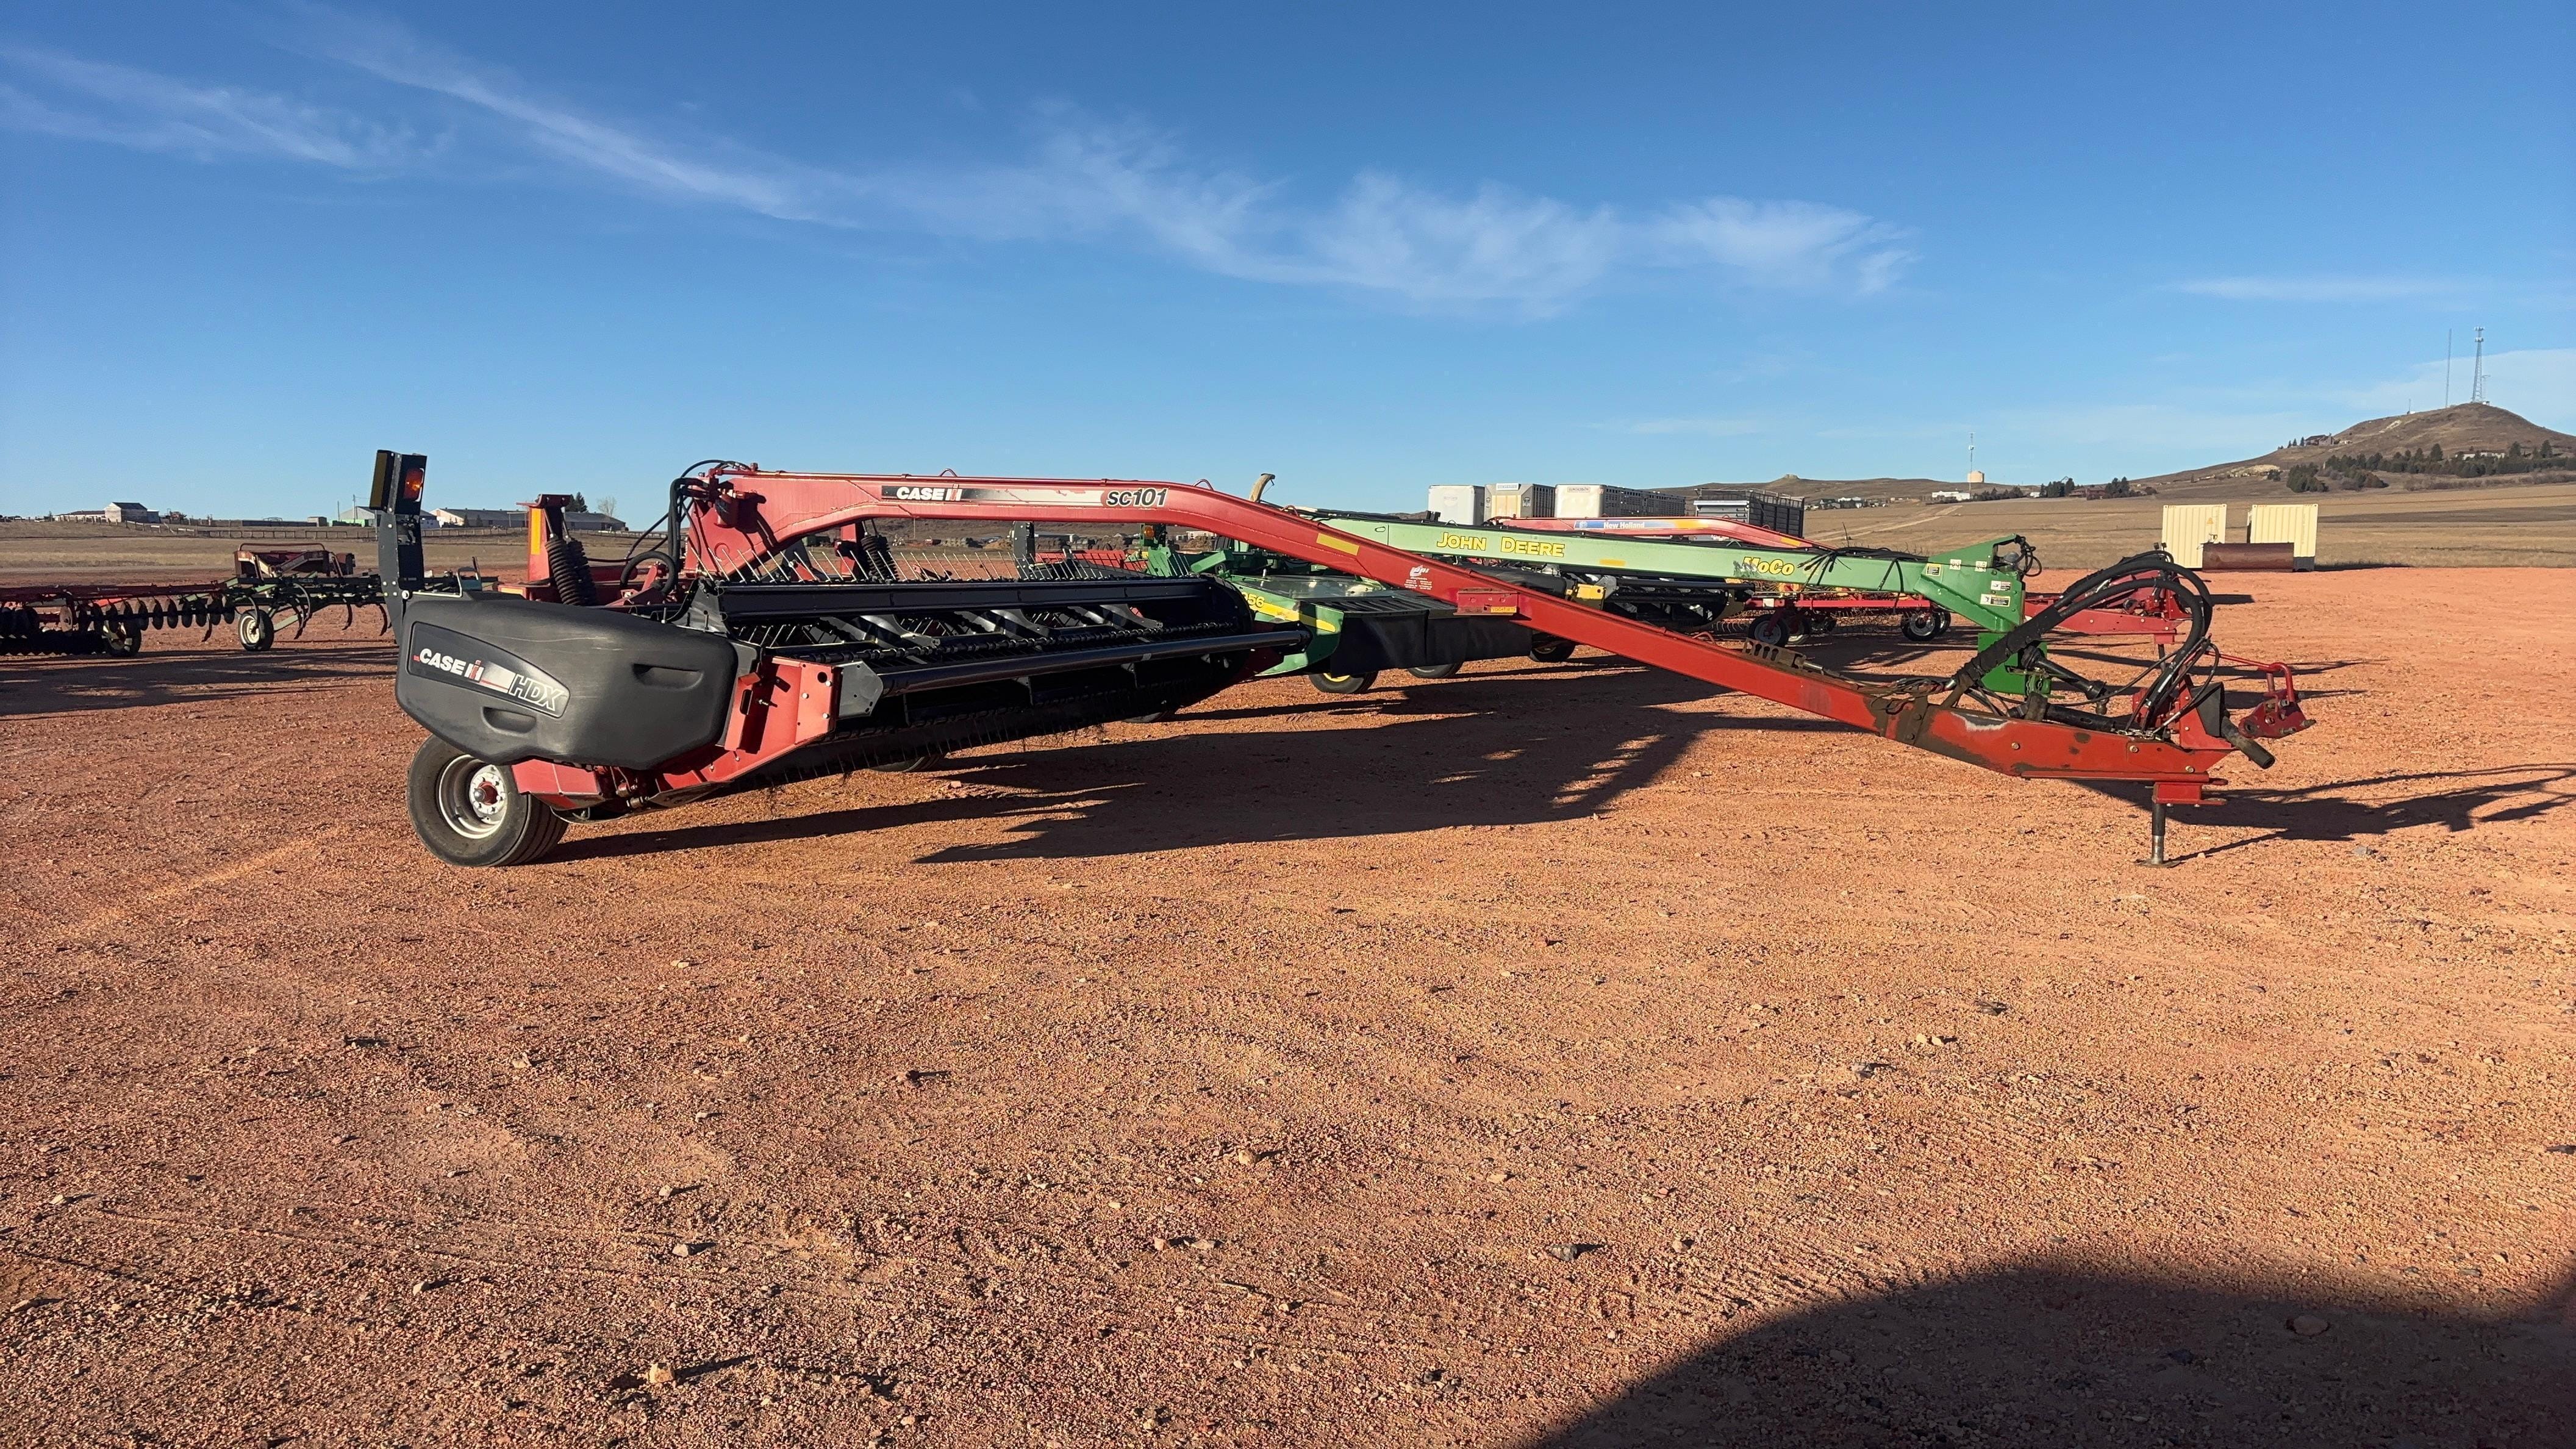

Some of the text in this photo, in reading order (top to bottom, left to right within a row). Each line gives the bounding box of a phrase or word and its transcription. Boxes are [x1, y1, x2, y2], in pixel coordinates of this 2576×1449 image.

[896, 487, 945, 501] CASE
[1106, 487, 1168, 507] SC101
[1436, 532, 1565, 557] JOHN DEERE
[1742, 556, 1795, 576] MoCo
[419, 648, 467, 675] CASE
[508, 673, 565, 712] HDX
